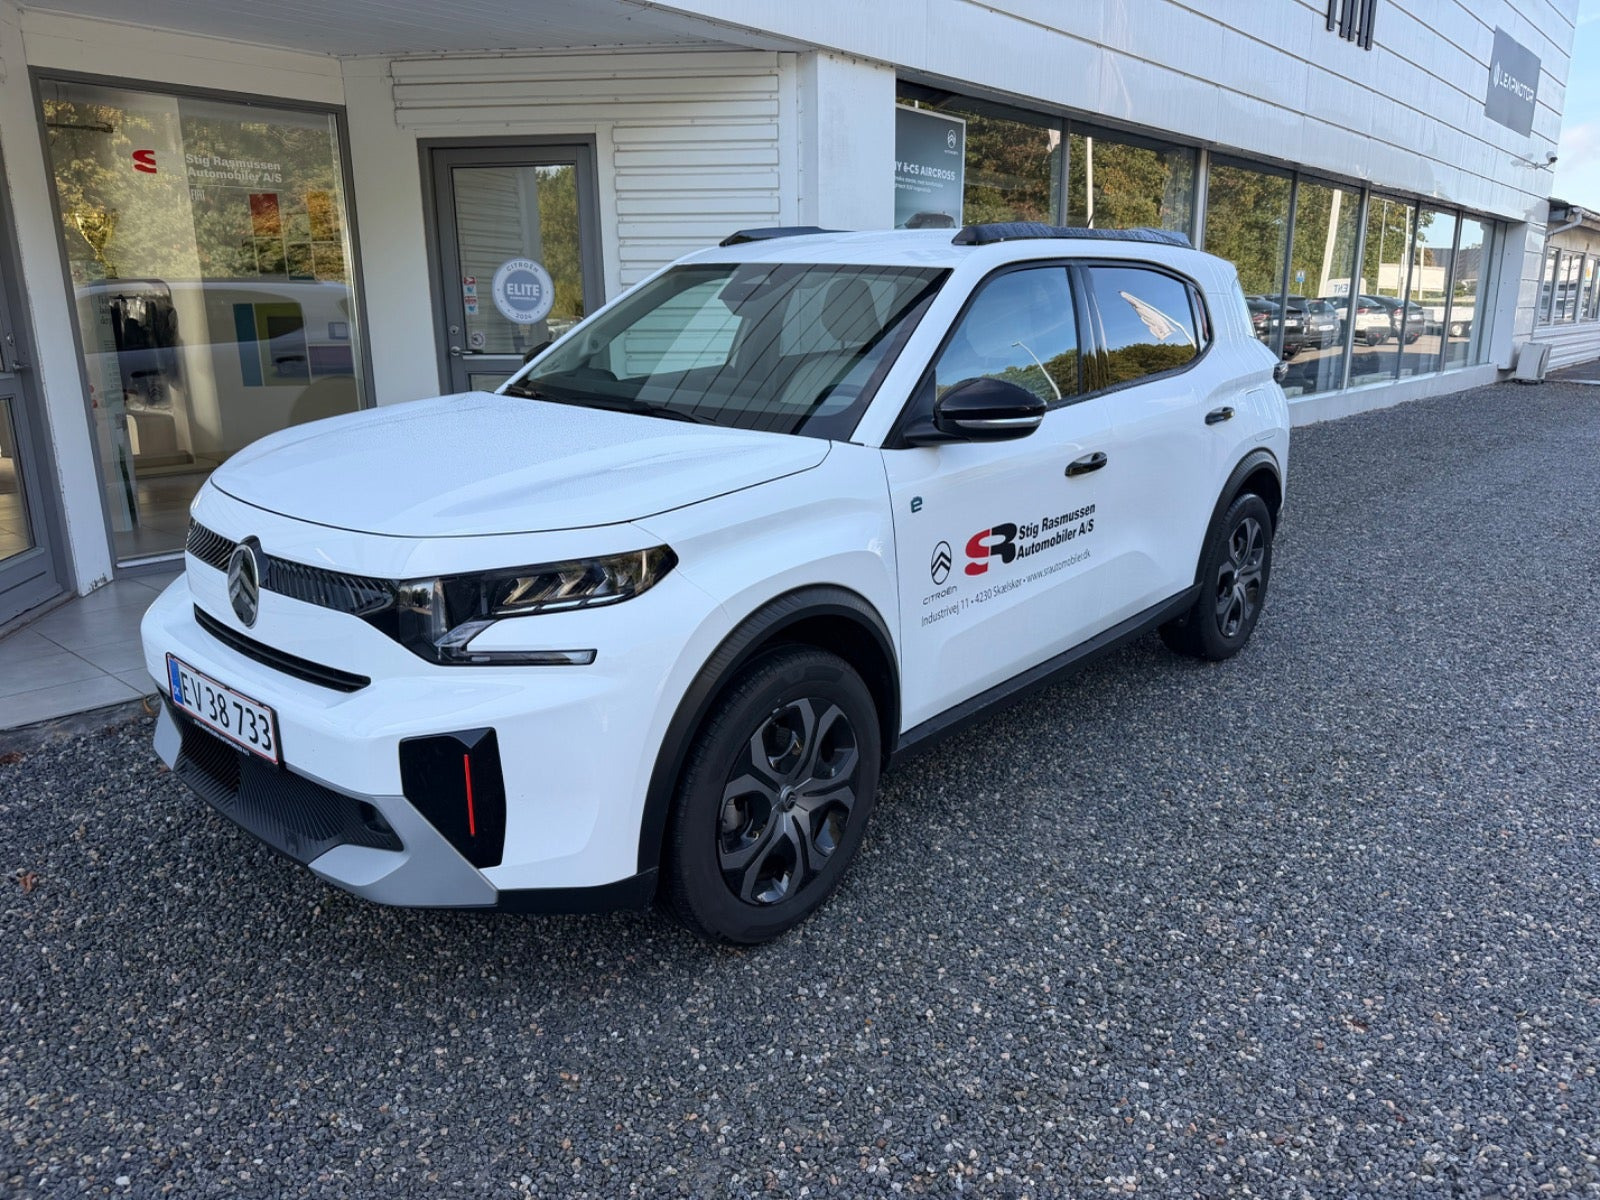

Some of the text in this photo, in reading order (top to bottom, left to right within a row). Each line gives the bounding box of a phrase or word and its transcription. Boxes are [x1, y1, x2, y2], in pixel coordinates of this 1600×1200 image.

[185, 153, 281, 171] Stig Rasmussen
[187, 166, 282, 184] Automobiler A/S
[920, 166, 956, 180] AIRCROSS
[506, 283, 540, 297] ELITE
[1018, 503, 1096, 541] Stig Rasmussen
[1016, 518, 1095, 561] Automobiler A/S
[921, 600, 960, 627] Industrivej
[960, 597, 969, 610] 11
[974, 588, 993, 603] 4230
[180, 671, 202, 712] EV
[206, 686, 230, 729] 38
[233, 701, 272, 751] 733
